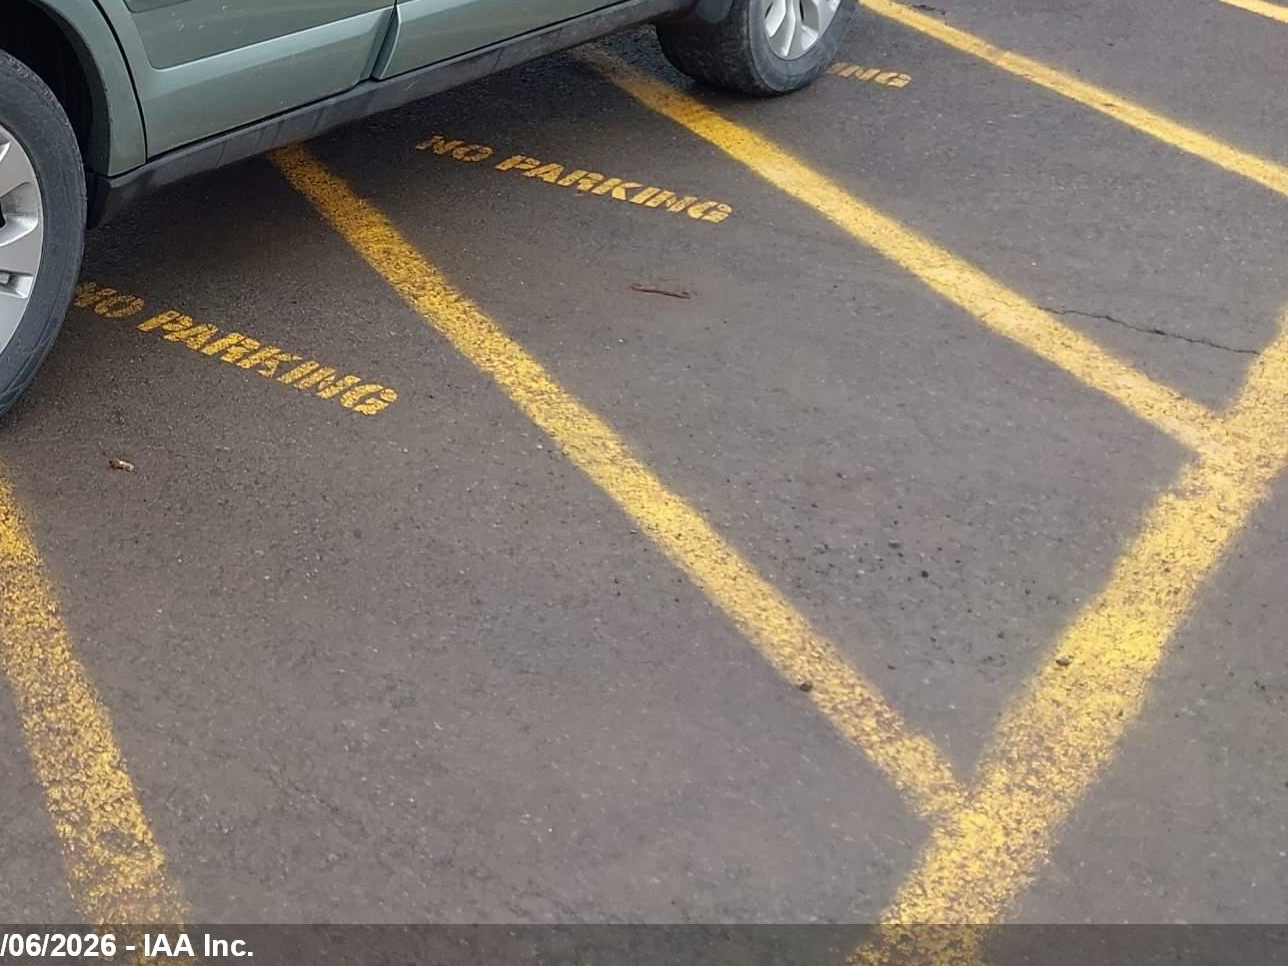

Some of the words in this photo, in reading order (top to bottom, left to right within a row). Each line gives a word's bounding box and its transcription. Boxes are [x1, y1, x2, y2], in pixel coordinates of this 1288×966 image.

[415, 135, 493, 162] NO
[495, 154, 733, 224] PARKING
[136, 309, 399, 416] PARKING
